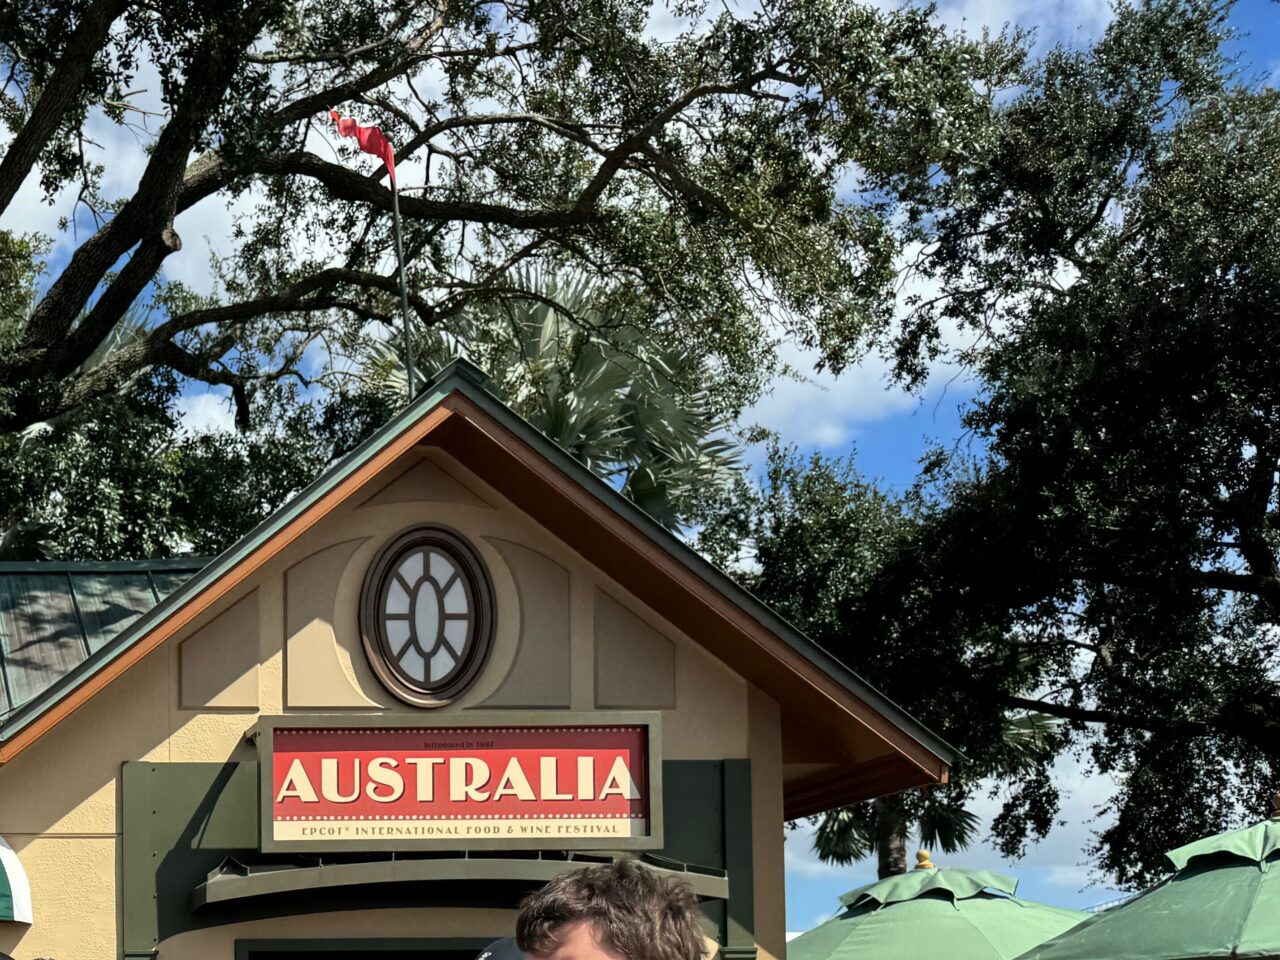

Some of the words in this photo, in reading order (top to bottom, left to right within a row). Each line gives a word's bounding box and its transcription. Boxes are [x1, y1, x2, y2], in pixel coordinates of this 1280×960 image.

[275, 755, 642, 804] AUSTRALIA
[301, 826, 344, 836] EPCOT
[355, 825, 461, 836] INTERNATIONAL
[466, 825, 501, 835] FOOD
[506, 825, 514, 834] &
[519, 824, 552, 835] WINE
[557, 823, 619, 834] FESTIVAL
